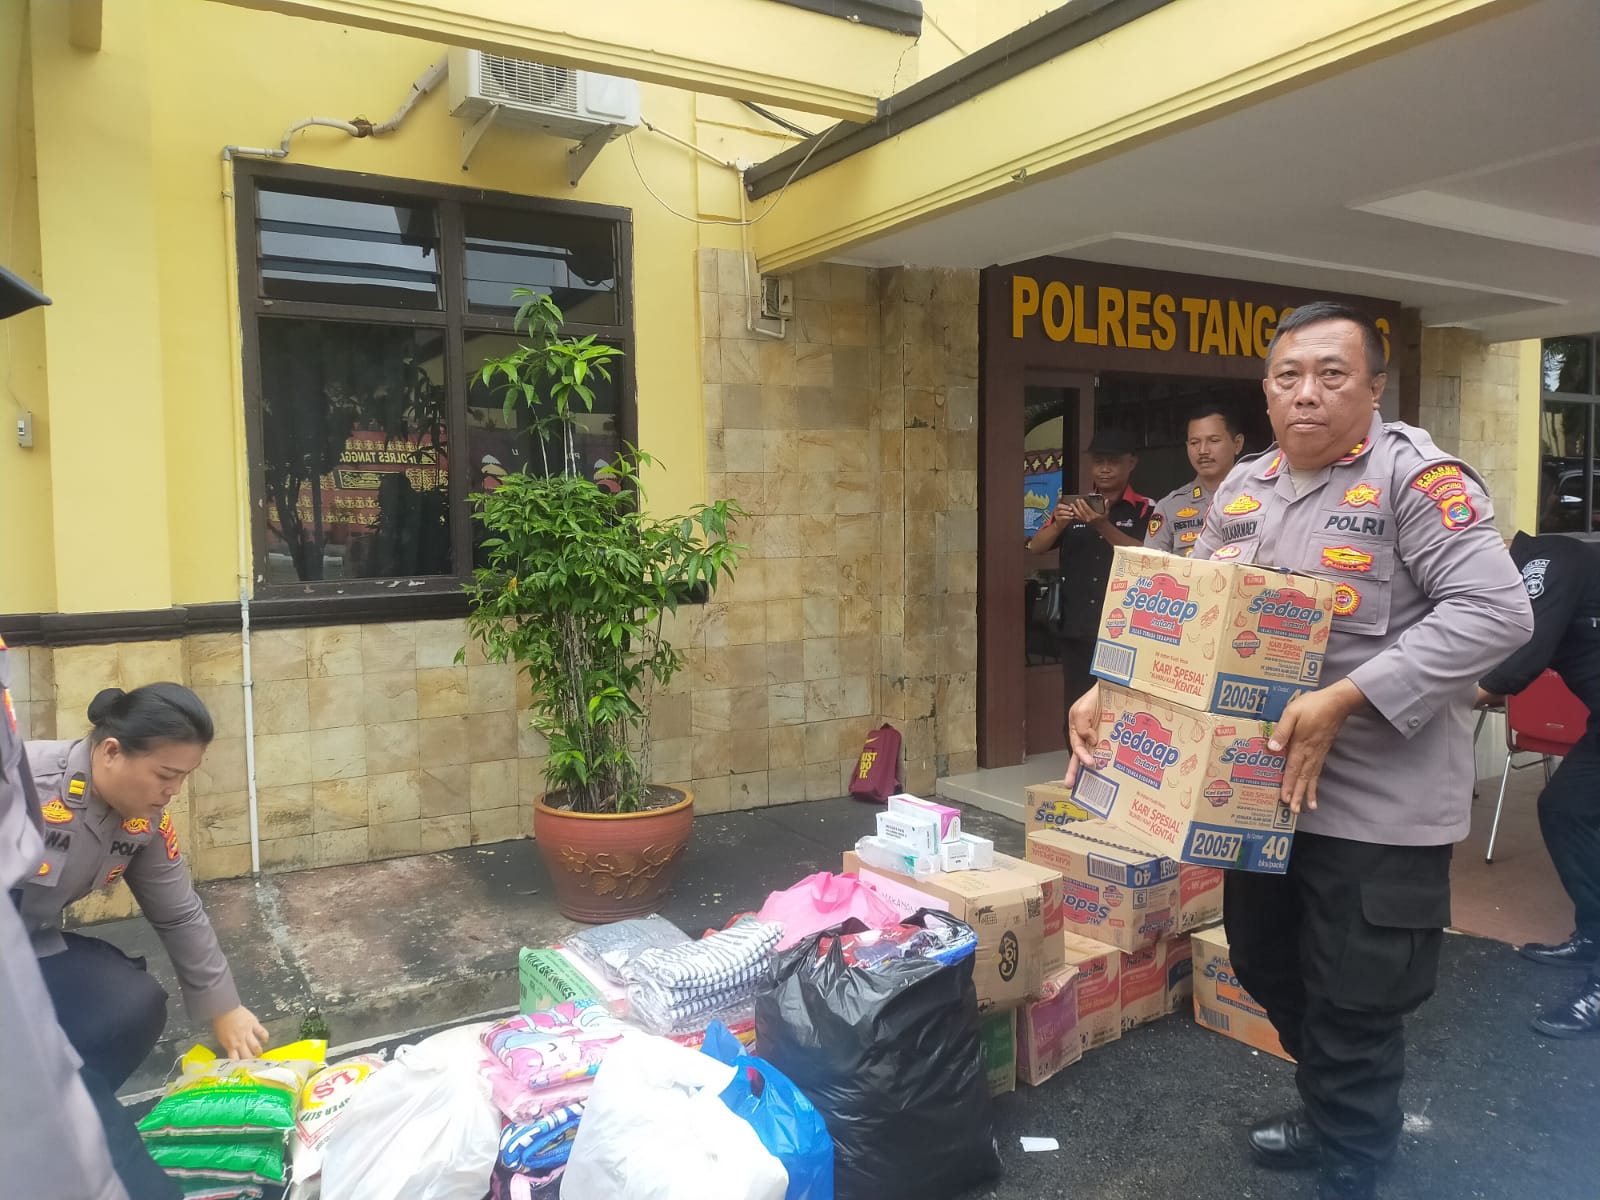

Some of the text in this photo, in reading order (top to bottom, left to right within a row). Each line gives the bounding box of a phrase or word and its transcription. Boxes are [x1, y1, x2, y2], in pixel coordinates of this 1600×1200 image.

[1012, 275, 1391, 364] POLRES TANGS
[1324, 515, 1385, 536] POLRI
[1136, 576, 1153, 588] Mie
[1263, 588, 1280, 598] Mie
[1123, 587, 1198, 624] Sedaap
[1249, 596, 1323, 625] Sedaap
[1153, 660, 1206, 686] KARI SPESIAL
[1308, 661, 1318, 676] 9
[1174, 680, 1202, 696] KENTAL
[1122, 711, 1136, 725] Mie
[1110, 720, 1179, 768] Sedaap
[1233, 738, 1250, 748] Mie
[1135, 755, 1158, 773] instant
[1131, 799, 1150, 817] KARI
[1150, 809, 1180, 834] SPESIAL
[1282, 808, 1290, 824] 9
[1150, 823, 1175, 844] KENTAL
[1193, 833, 1241, 859] 20057
[1262, 835, 1289, 861] 40
[1134, 869, 1151, 886] 40
[1087, 915, 1102, 926] Mie
[313, 1070, 355, 1099] LS
